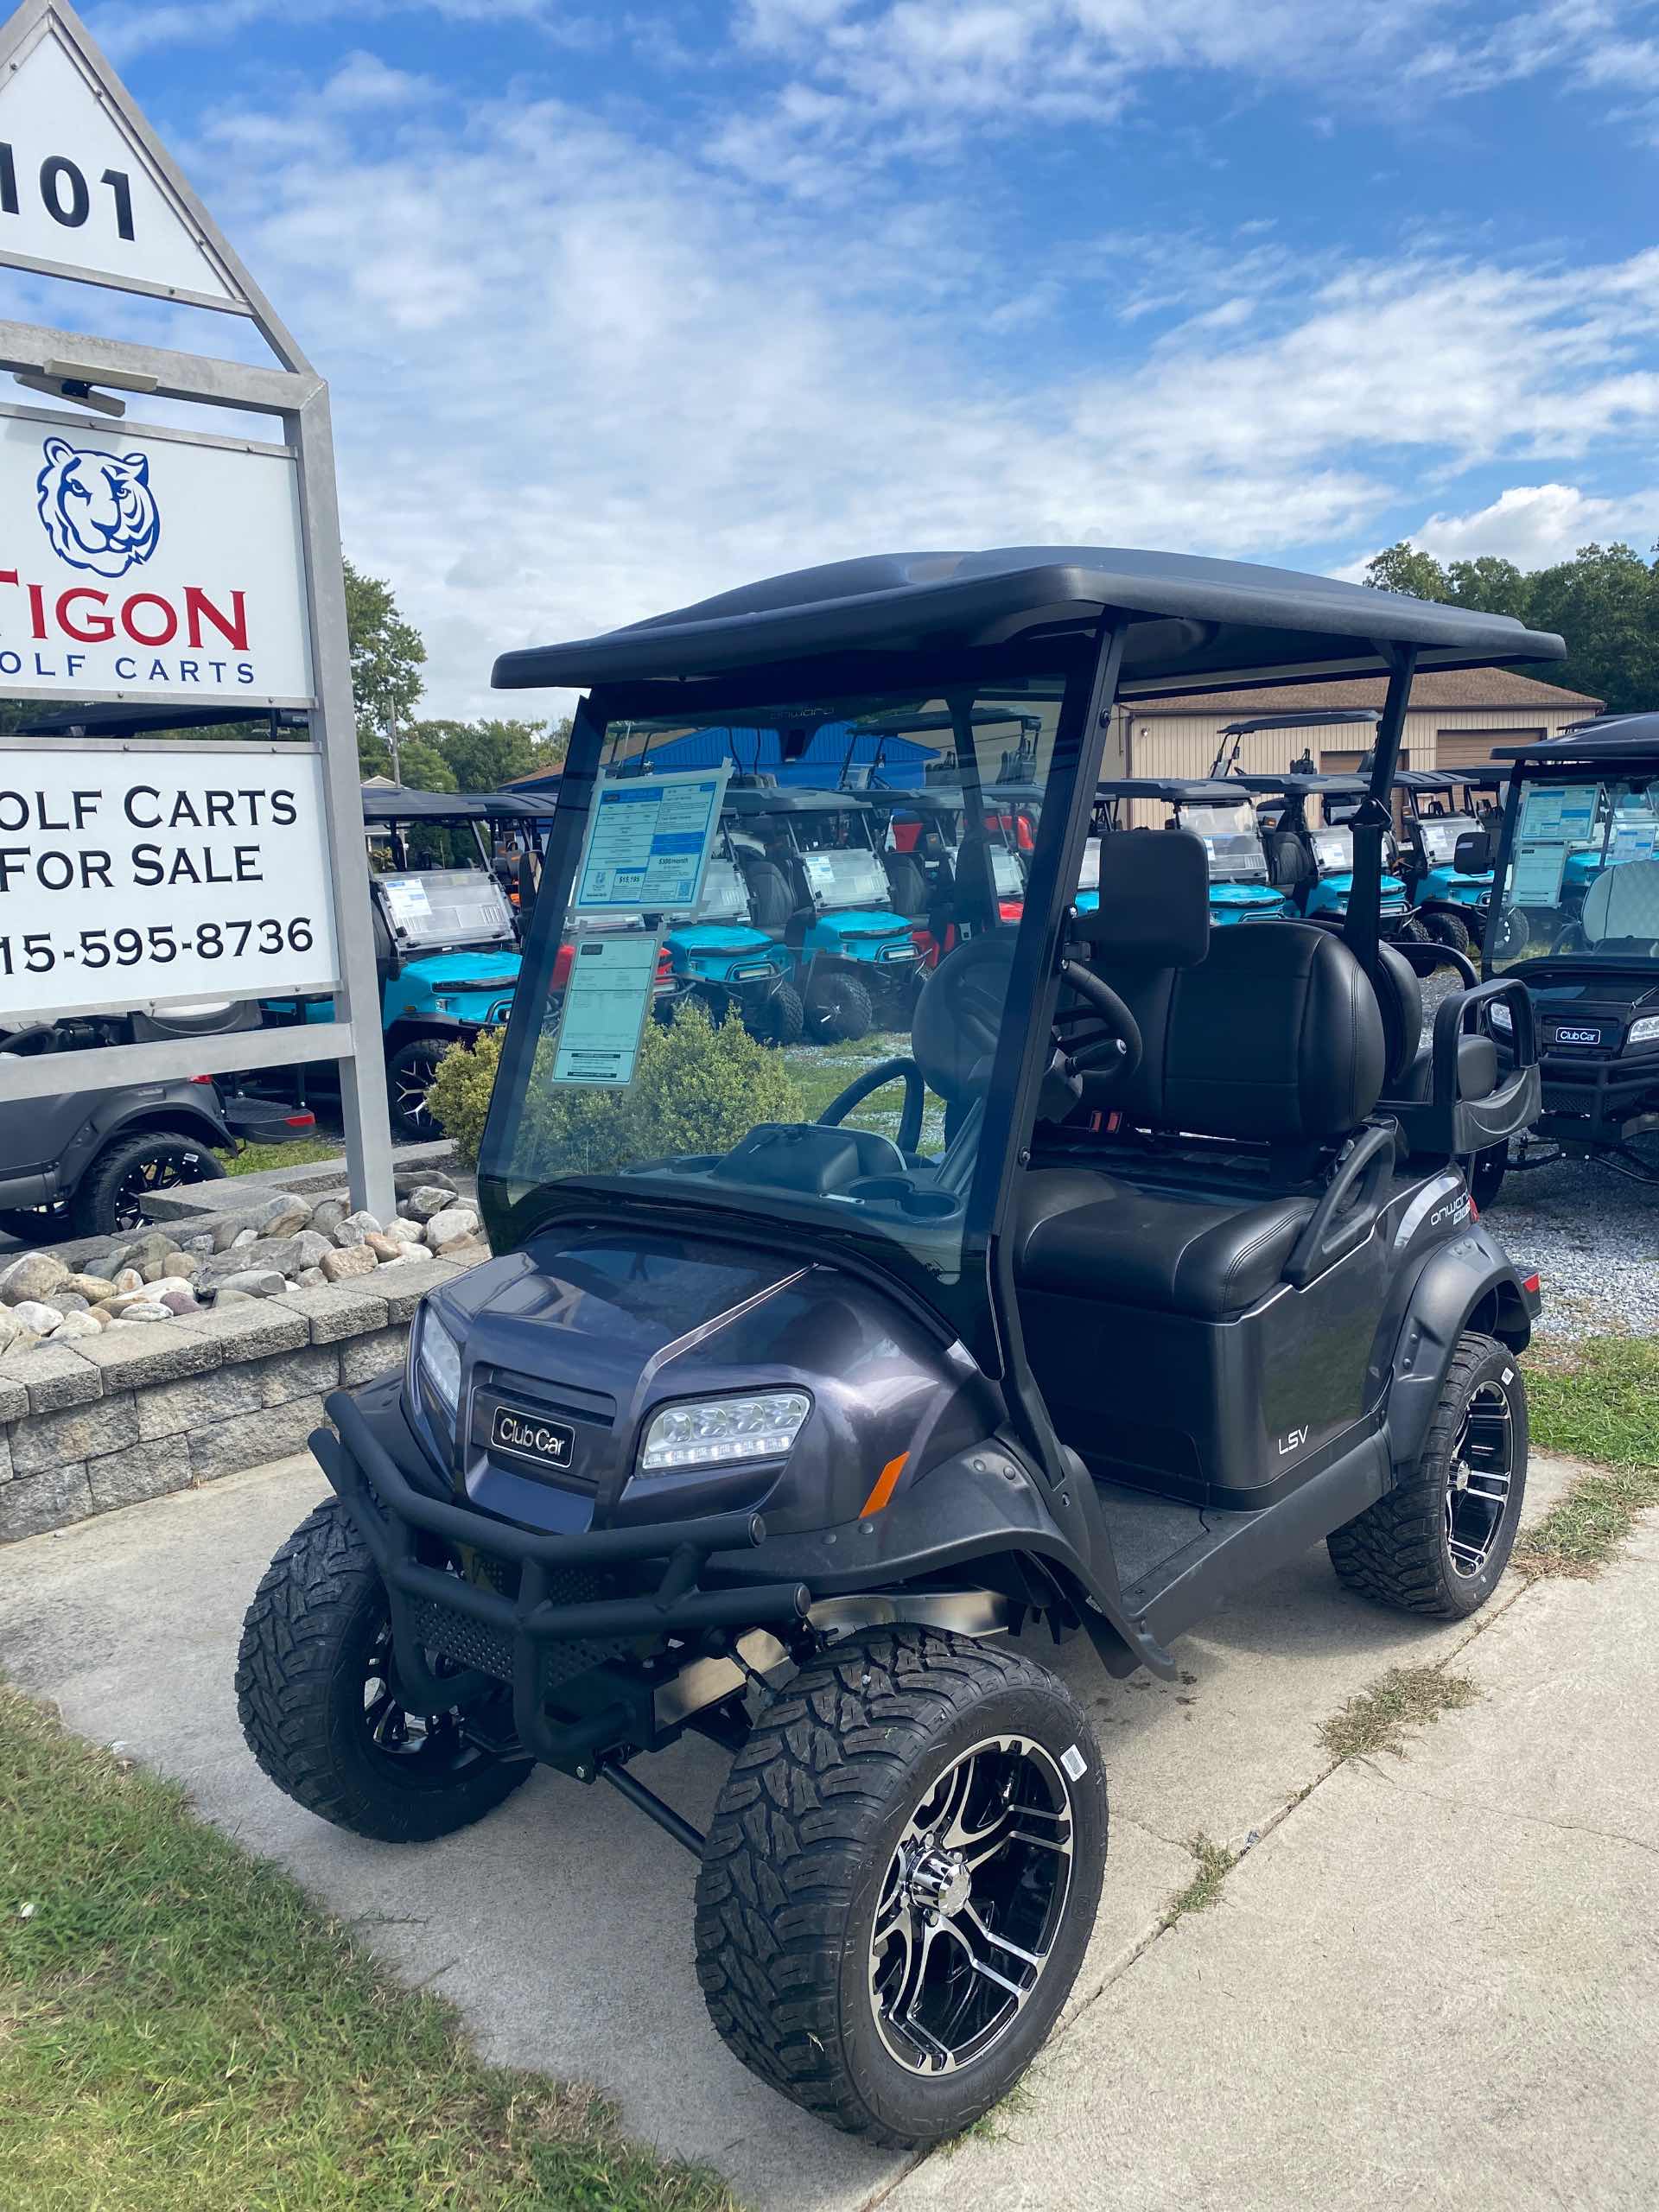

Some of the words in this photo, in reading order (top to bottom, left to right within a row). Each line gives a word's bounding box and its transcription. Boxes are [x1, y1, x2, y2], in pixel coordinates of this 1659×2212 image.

[0, 142, 135, 241] 101
[115, 657, 254, 684] CARTS
[124, 785, 297, 829] CARTS
[0, 845, 115, 893] FOR
[131, 843, 264, 887] SALE
[1560, 1030, 1580, 1040] Club
[1580, 1032, 1596, 1041] Car
[499, 1417, 534, 1447] Club
[535, 1427, 565, 1456] Car
[1279, 1424, 1308, 1455] LSV
